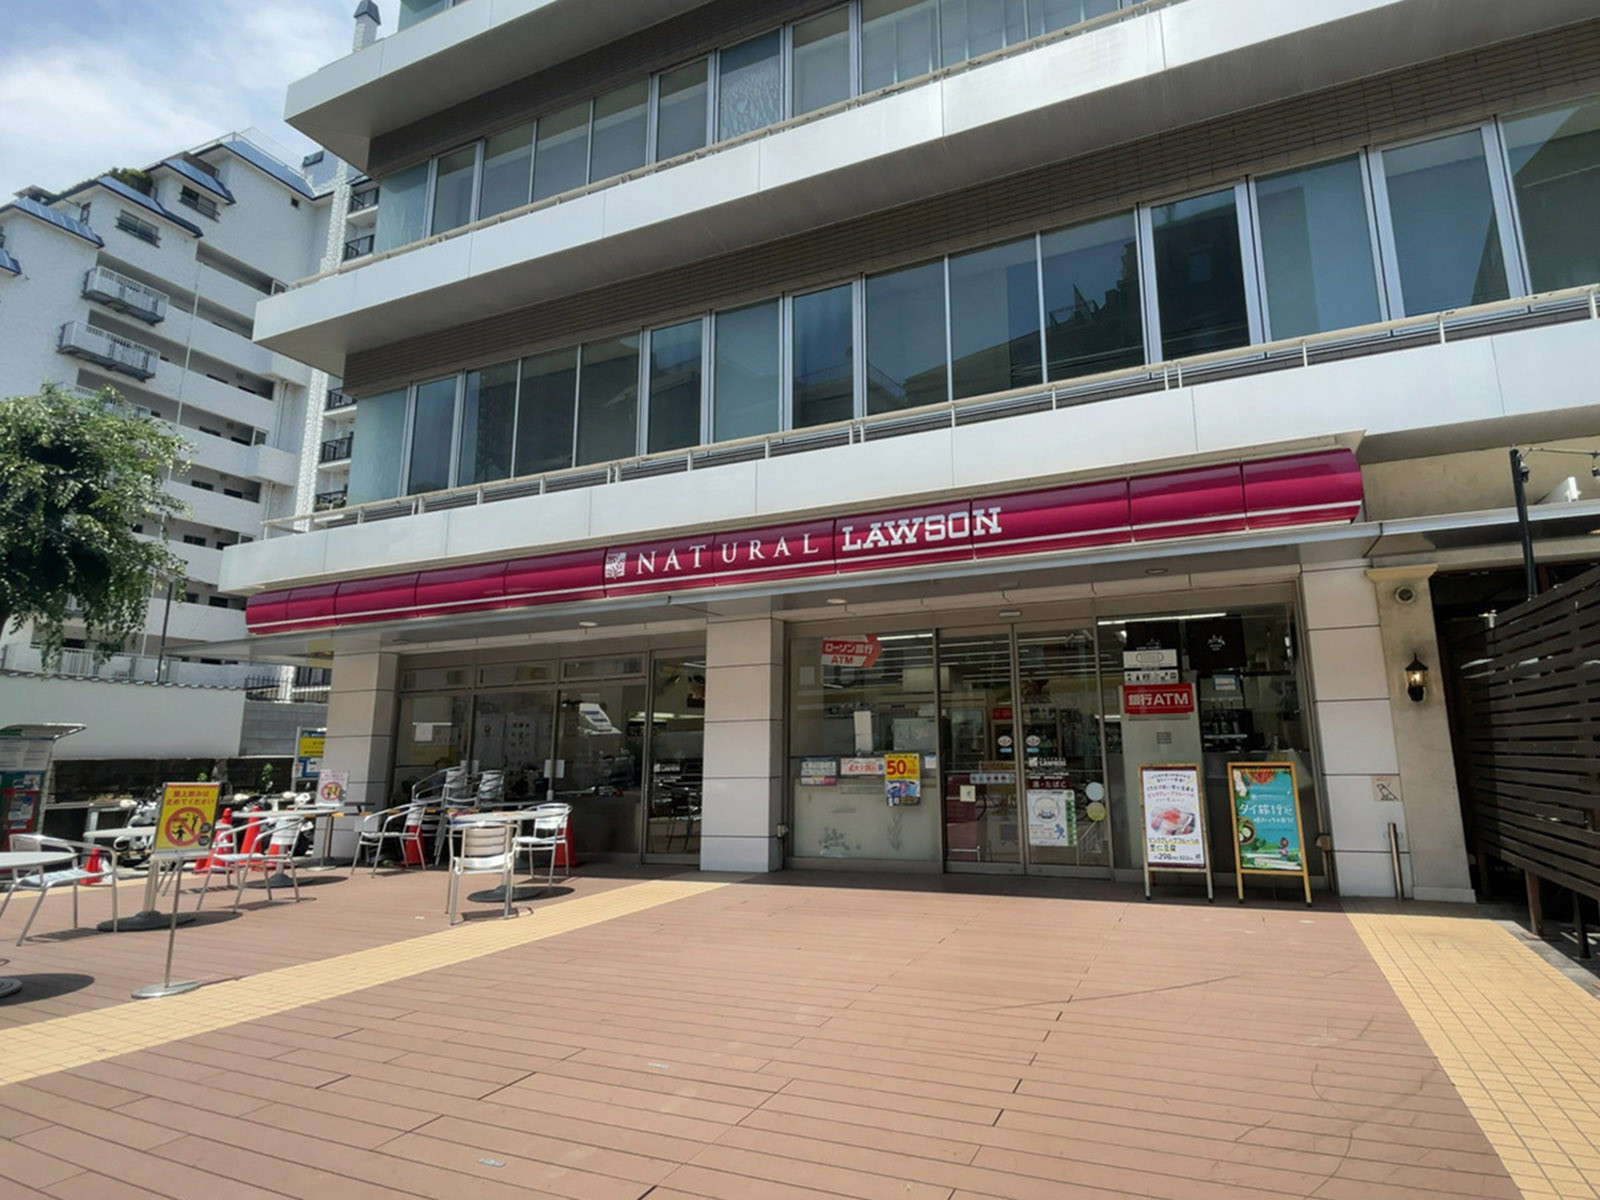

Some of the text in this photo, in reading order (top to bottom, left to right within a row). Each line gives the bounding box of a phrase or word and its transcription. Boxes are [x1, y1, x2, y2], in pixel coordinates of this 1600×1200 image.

[636, 507, 1002, 575] NATURAL LAWSON
[824, 642, 874, 655] ローソン銀行
[831, 655, 854, 665] ATM
